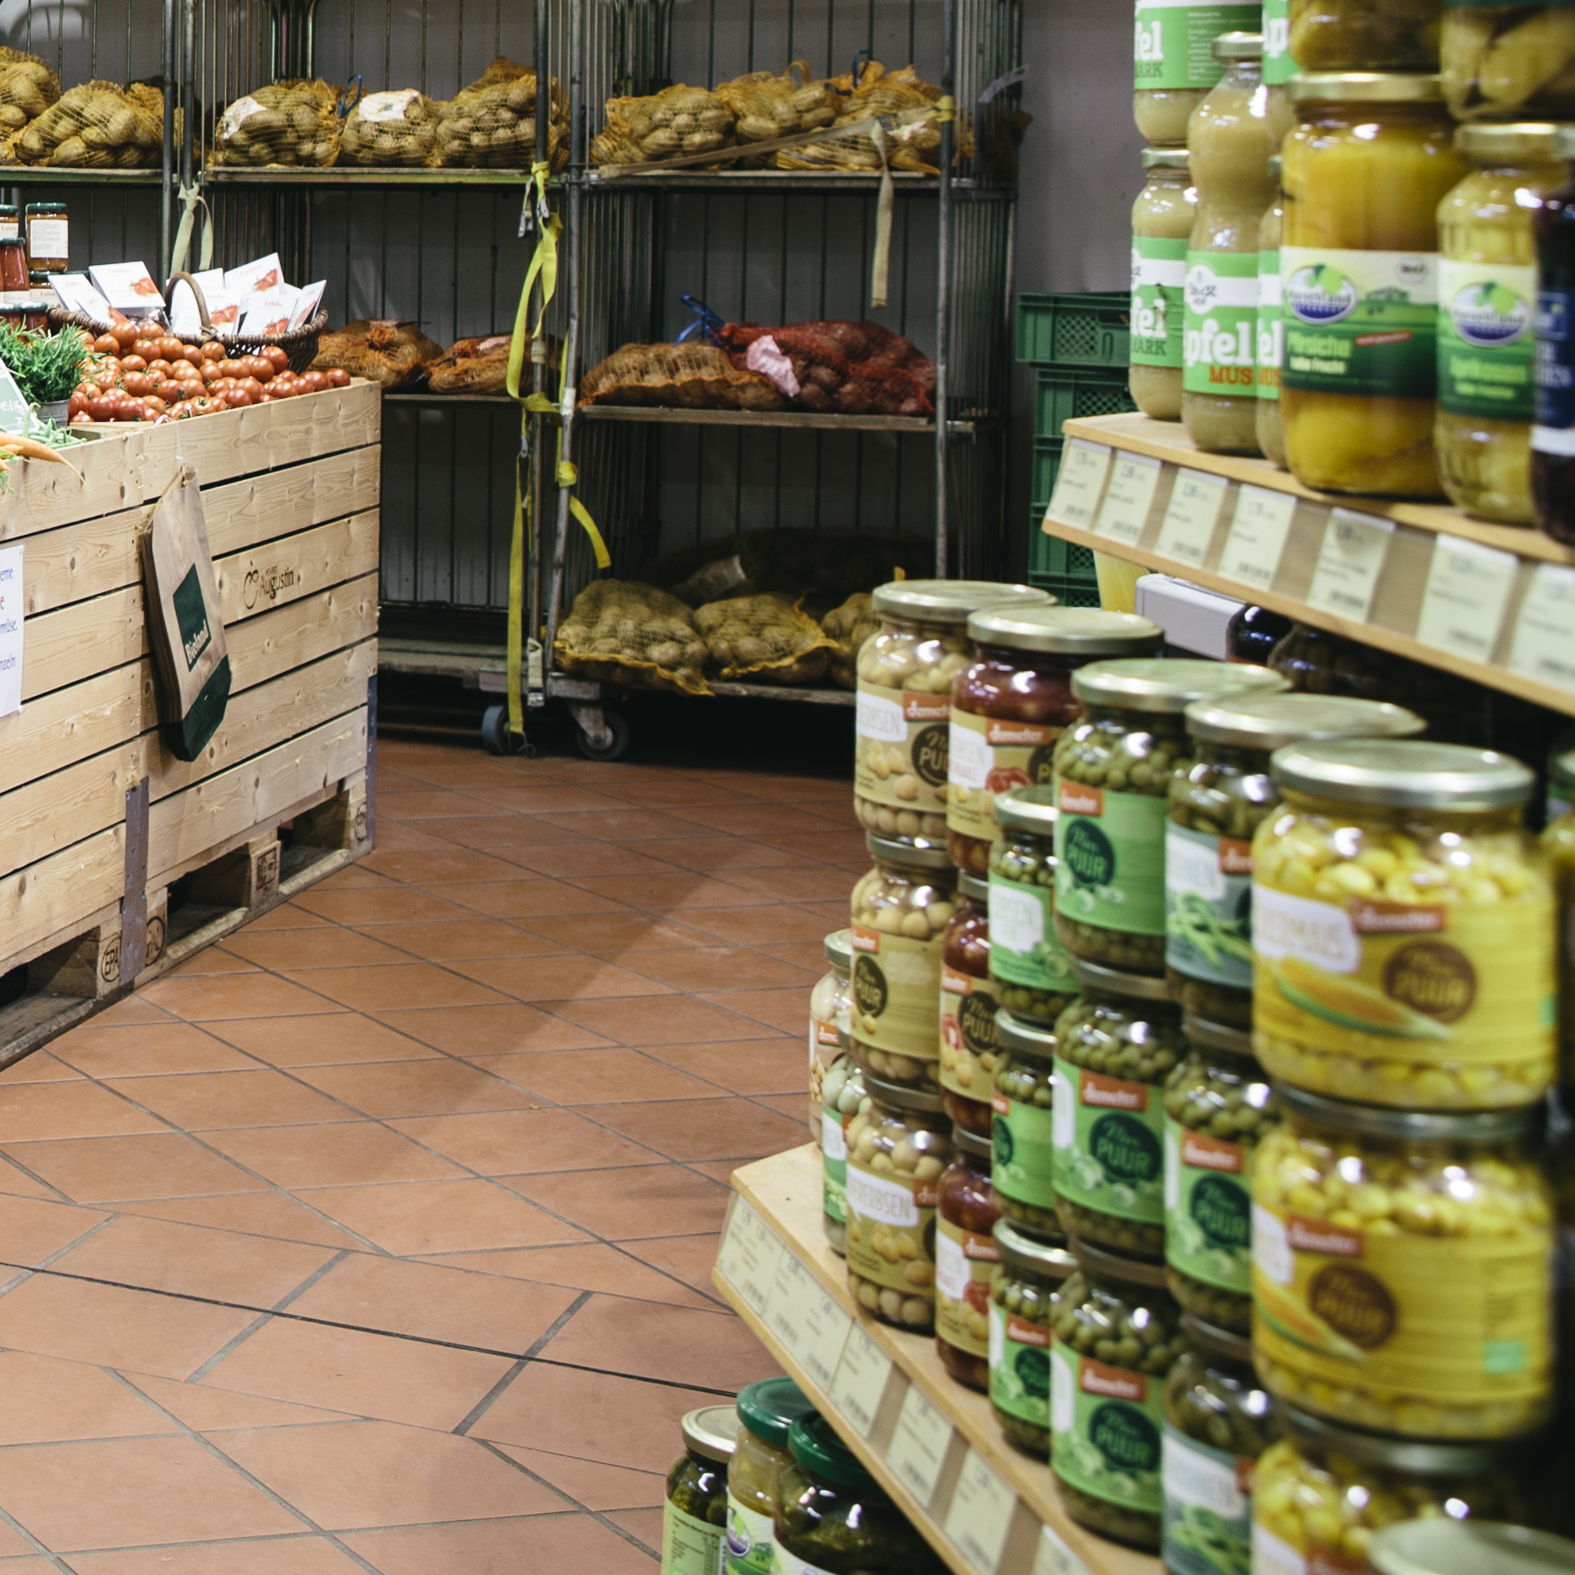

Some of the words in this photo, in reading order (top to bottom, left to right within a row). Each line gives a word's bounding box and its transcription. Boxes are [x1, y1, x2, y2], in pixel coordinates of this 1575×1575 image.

[1184, 316, 1253, 368] pfel
[185, 618, 210, 666] Bioland
[988, 722, 1044, 744] demeter
